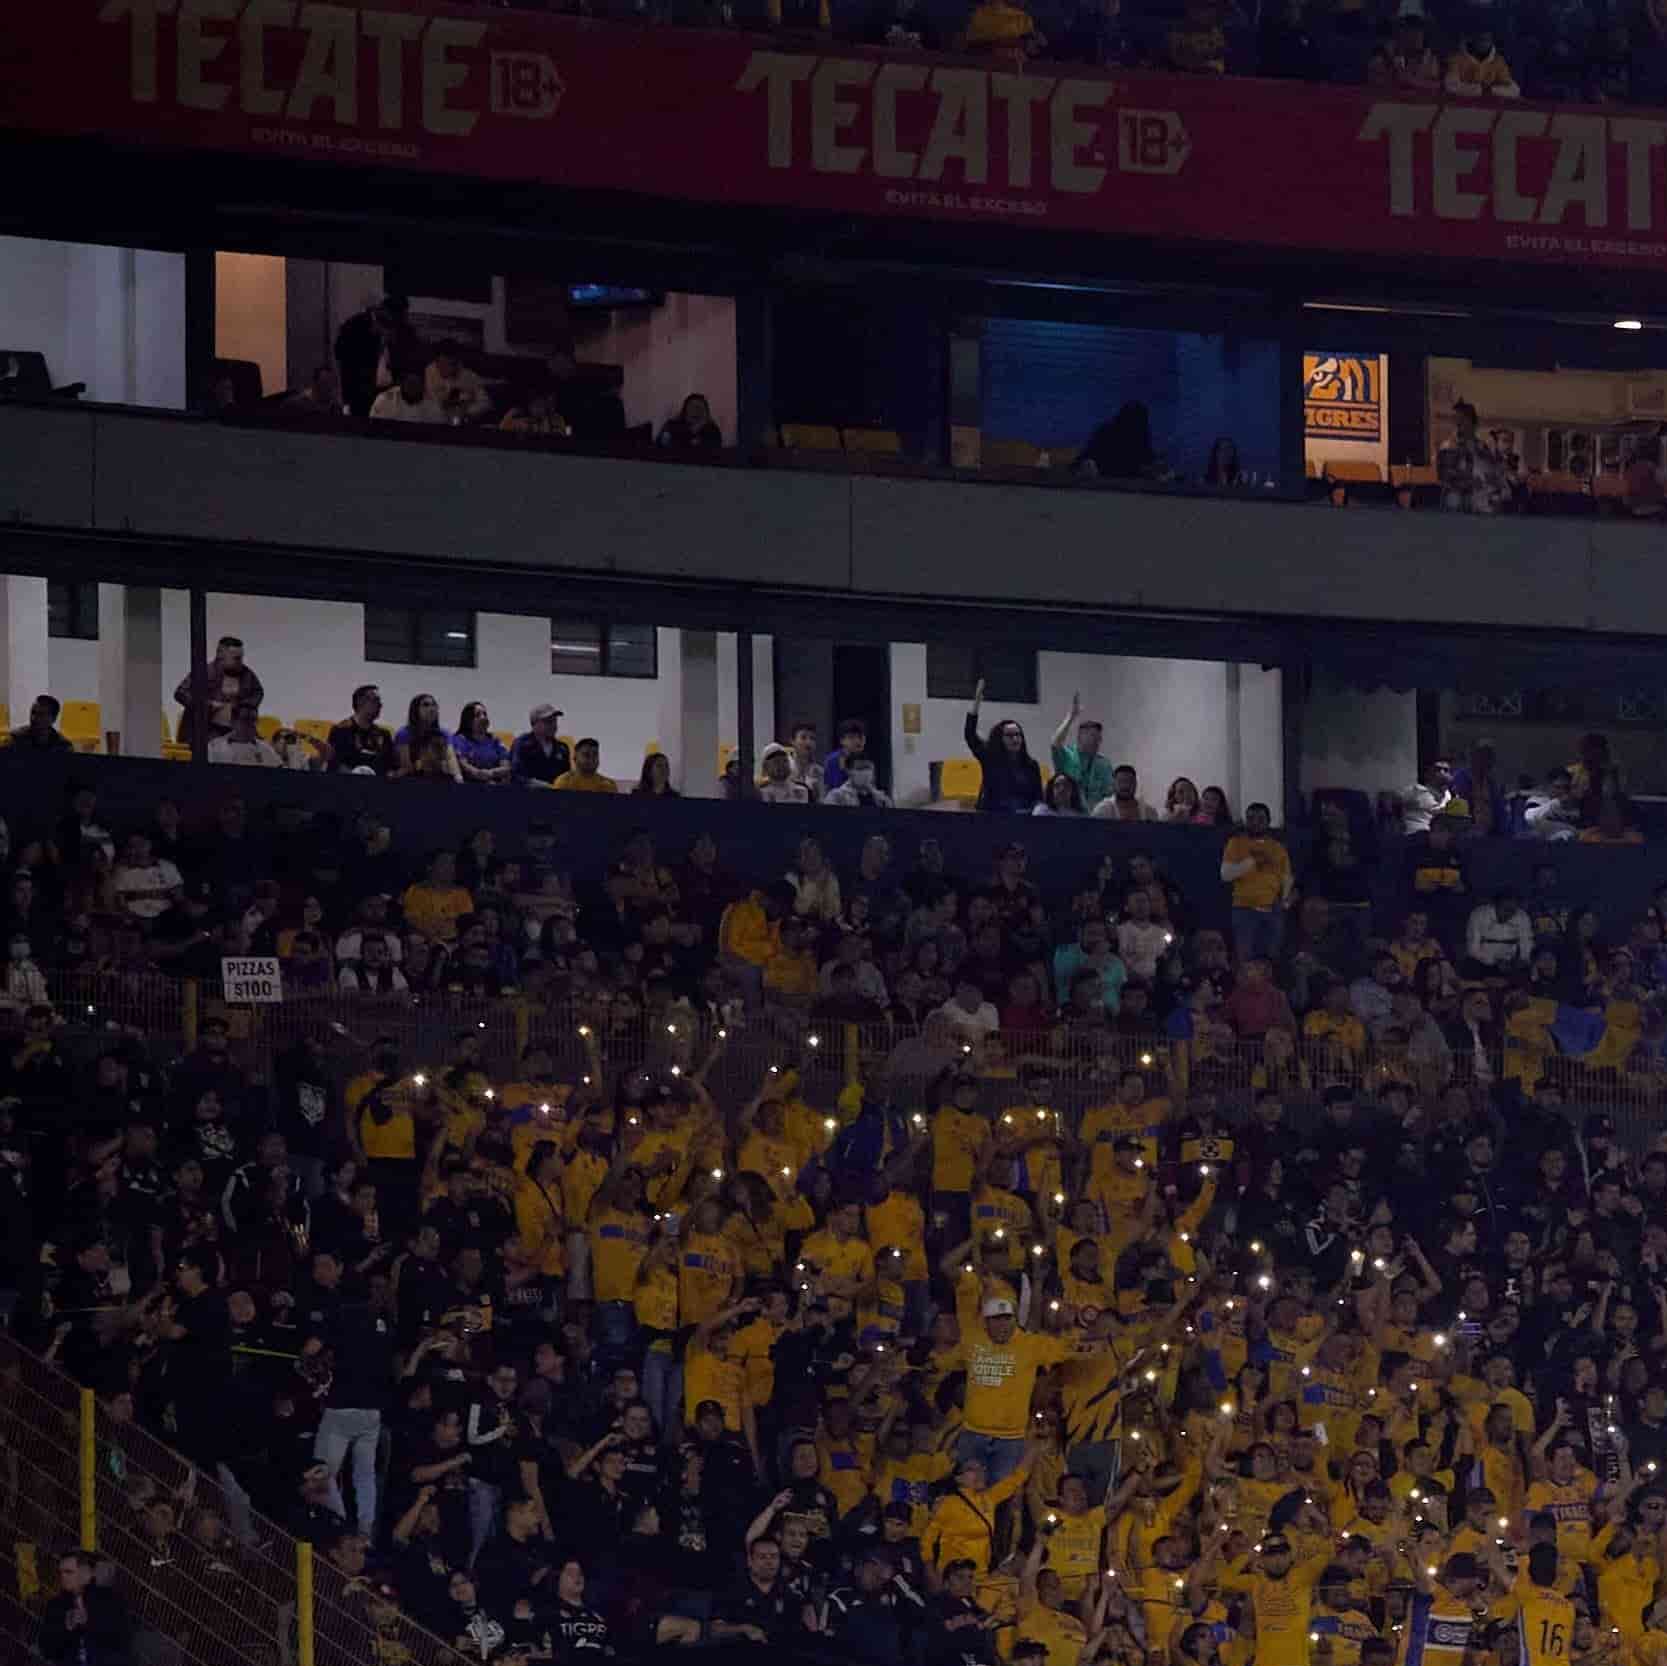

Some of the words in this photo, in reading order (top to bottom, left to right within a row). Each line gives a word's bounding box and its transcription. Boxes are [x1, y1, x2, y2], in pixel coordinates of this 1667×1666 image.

[97, 0, 488, 136] TECATE
[735, 50, 1114, 193] TECATE
[227, 961, 274, 976] PIZZAS
[1540, 1619, 1564, 1657] 16
